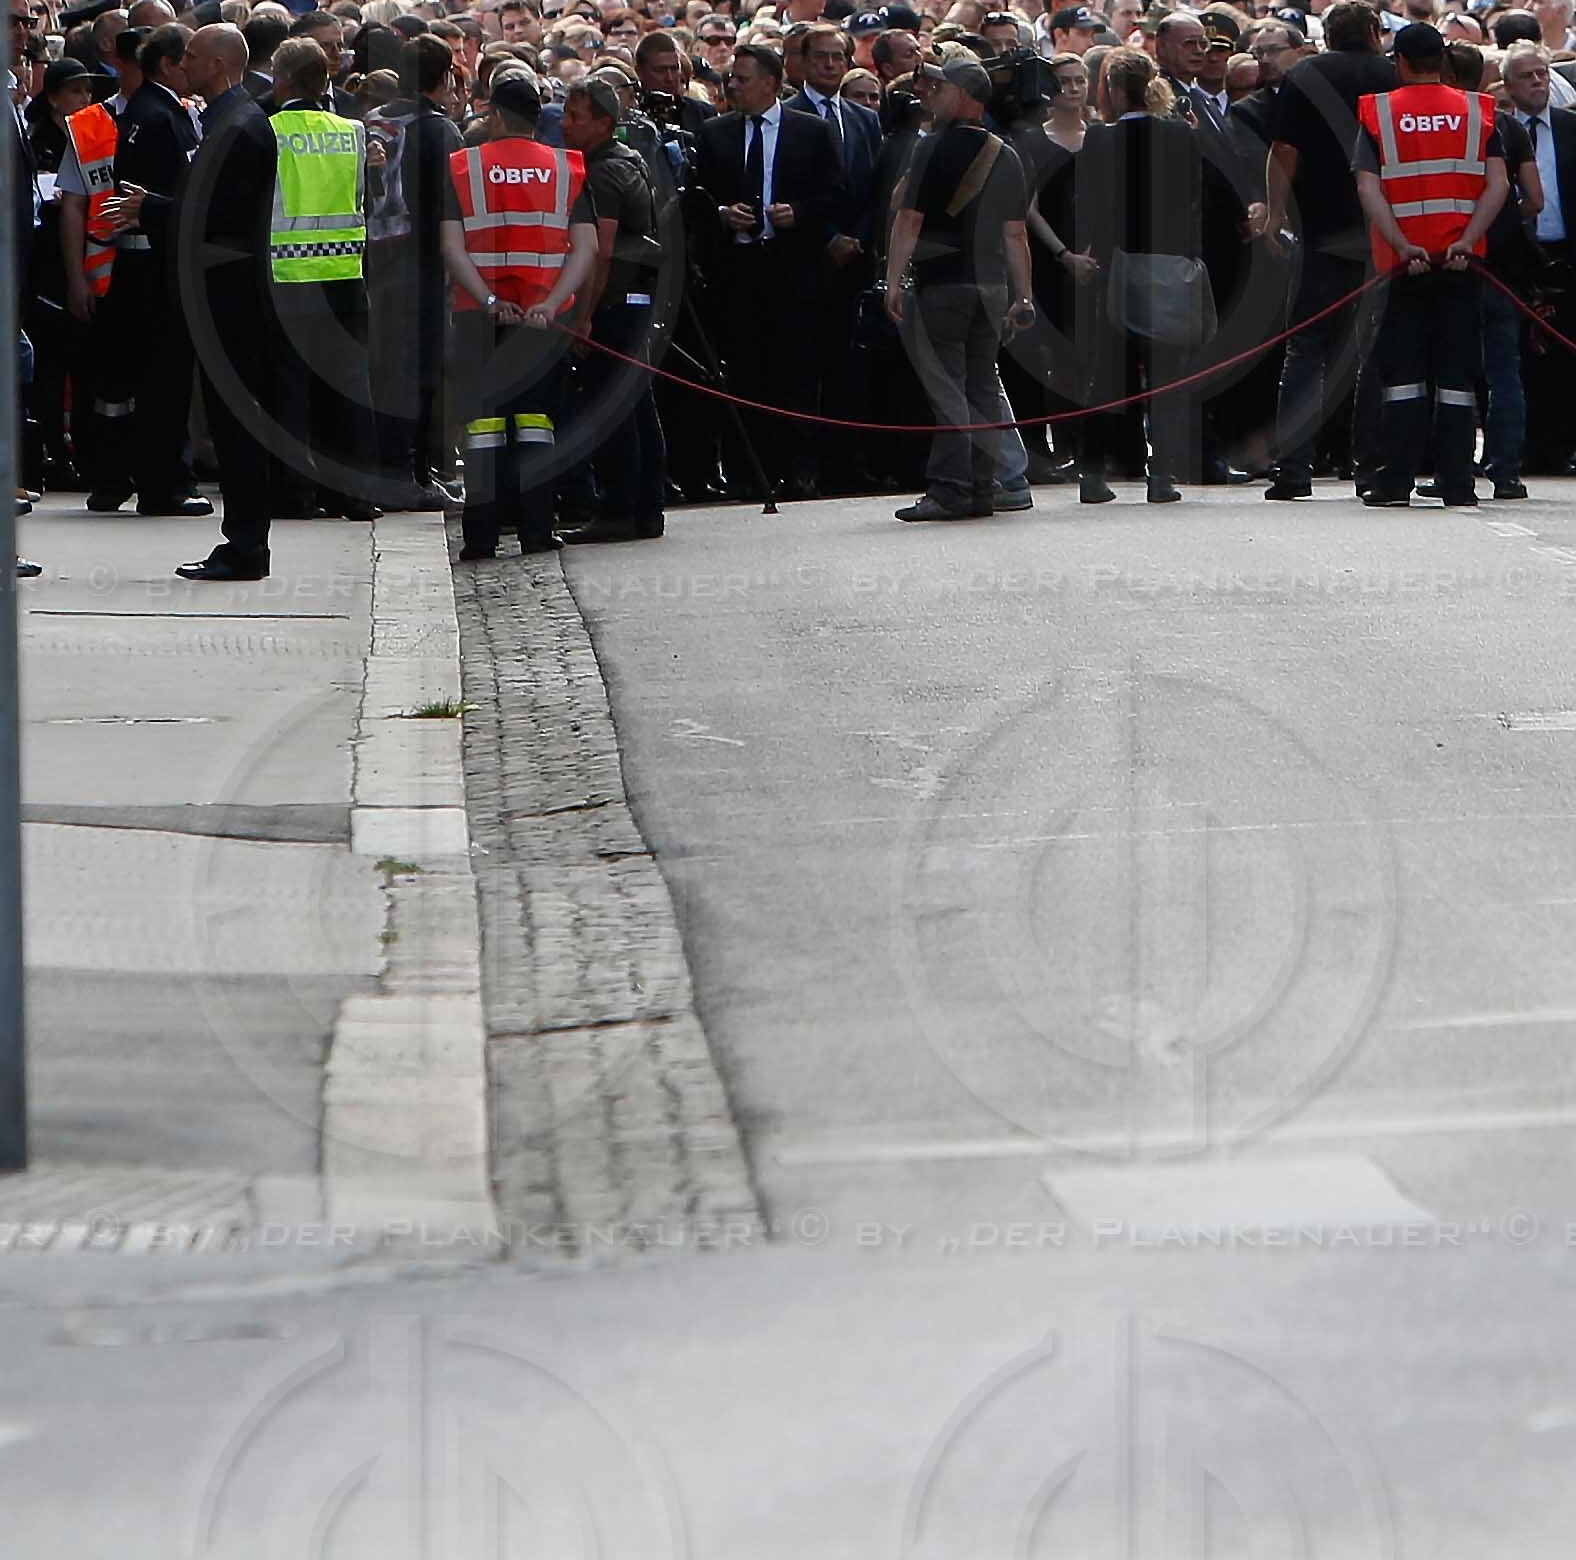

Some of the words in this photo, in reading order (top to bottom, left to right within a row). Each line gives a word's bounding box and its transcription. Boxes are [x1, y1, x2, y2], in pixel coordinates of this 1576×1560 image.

[1400, 113, 1461, 132] ÖBFV
[276, 132, 356, 154] POLIZEI
[489, 165, 551, 184] ÖBFV
